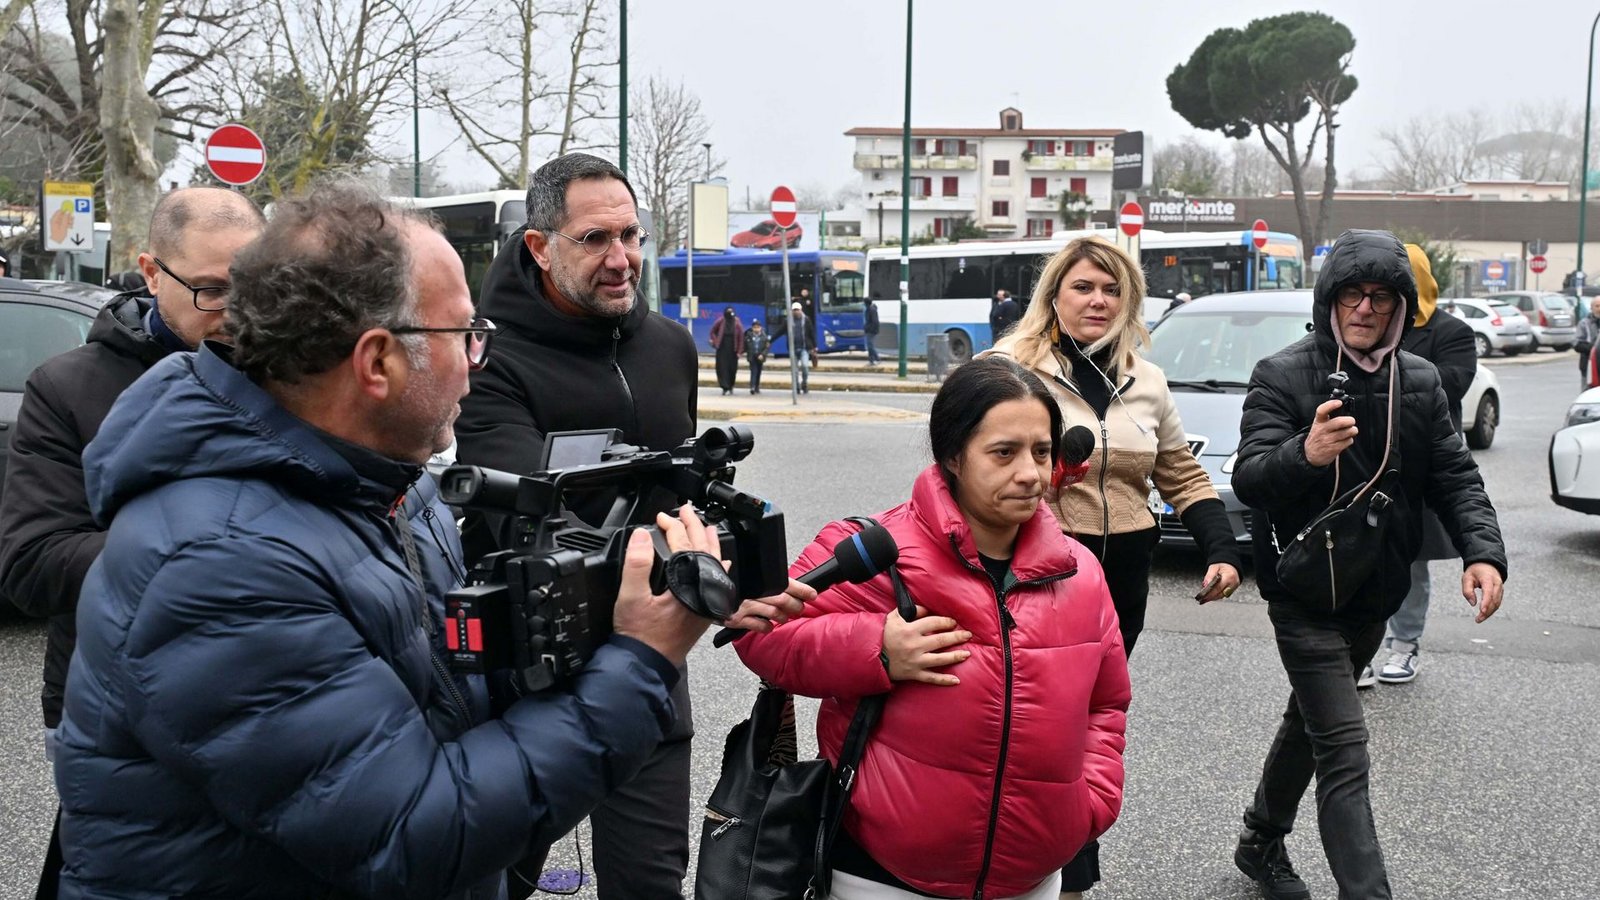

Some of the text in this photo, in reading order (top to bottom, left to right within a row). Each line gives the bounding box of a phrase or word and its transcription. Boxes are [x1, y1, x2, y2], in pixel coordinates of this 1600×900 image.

[78, 200, 88, 211] P
[1148, 200, 1236, 214] merkante
[1530, 260, 1547, 268] STOP
